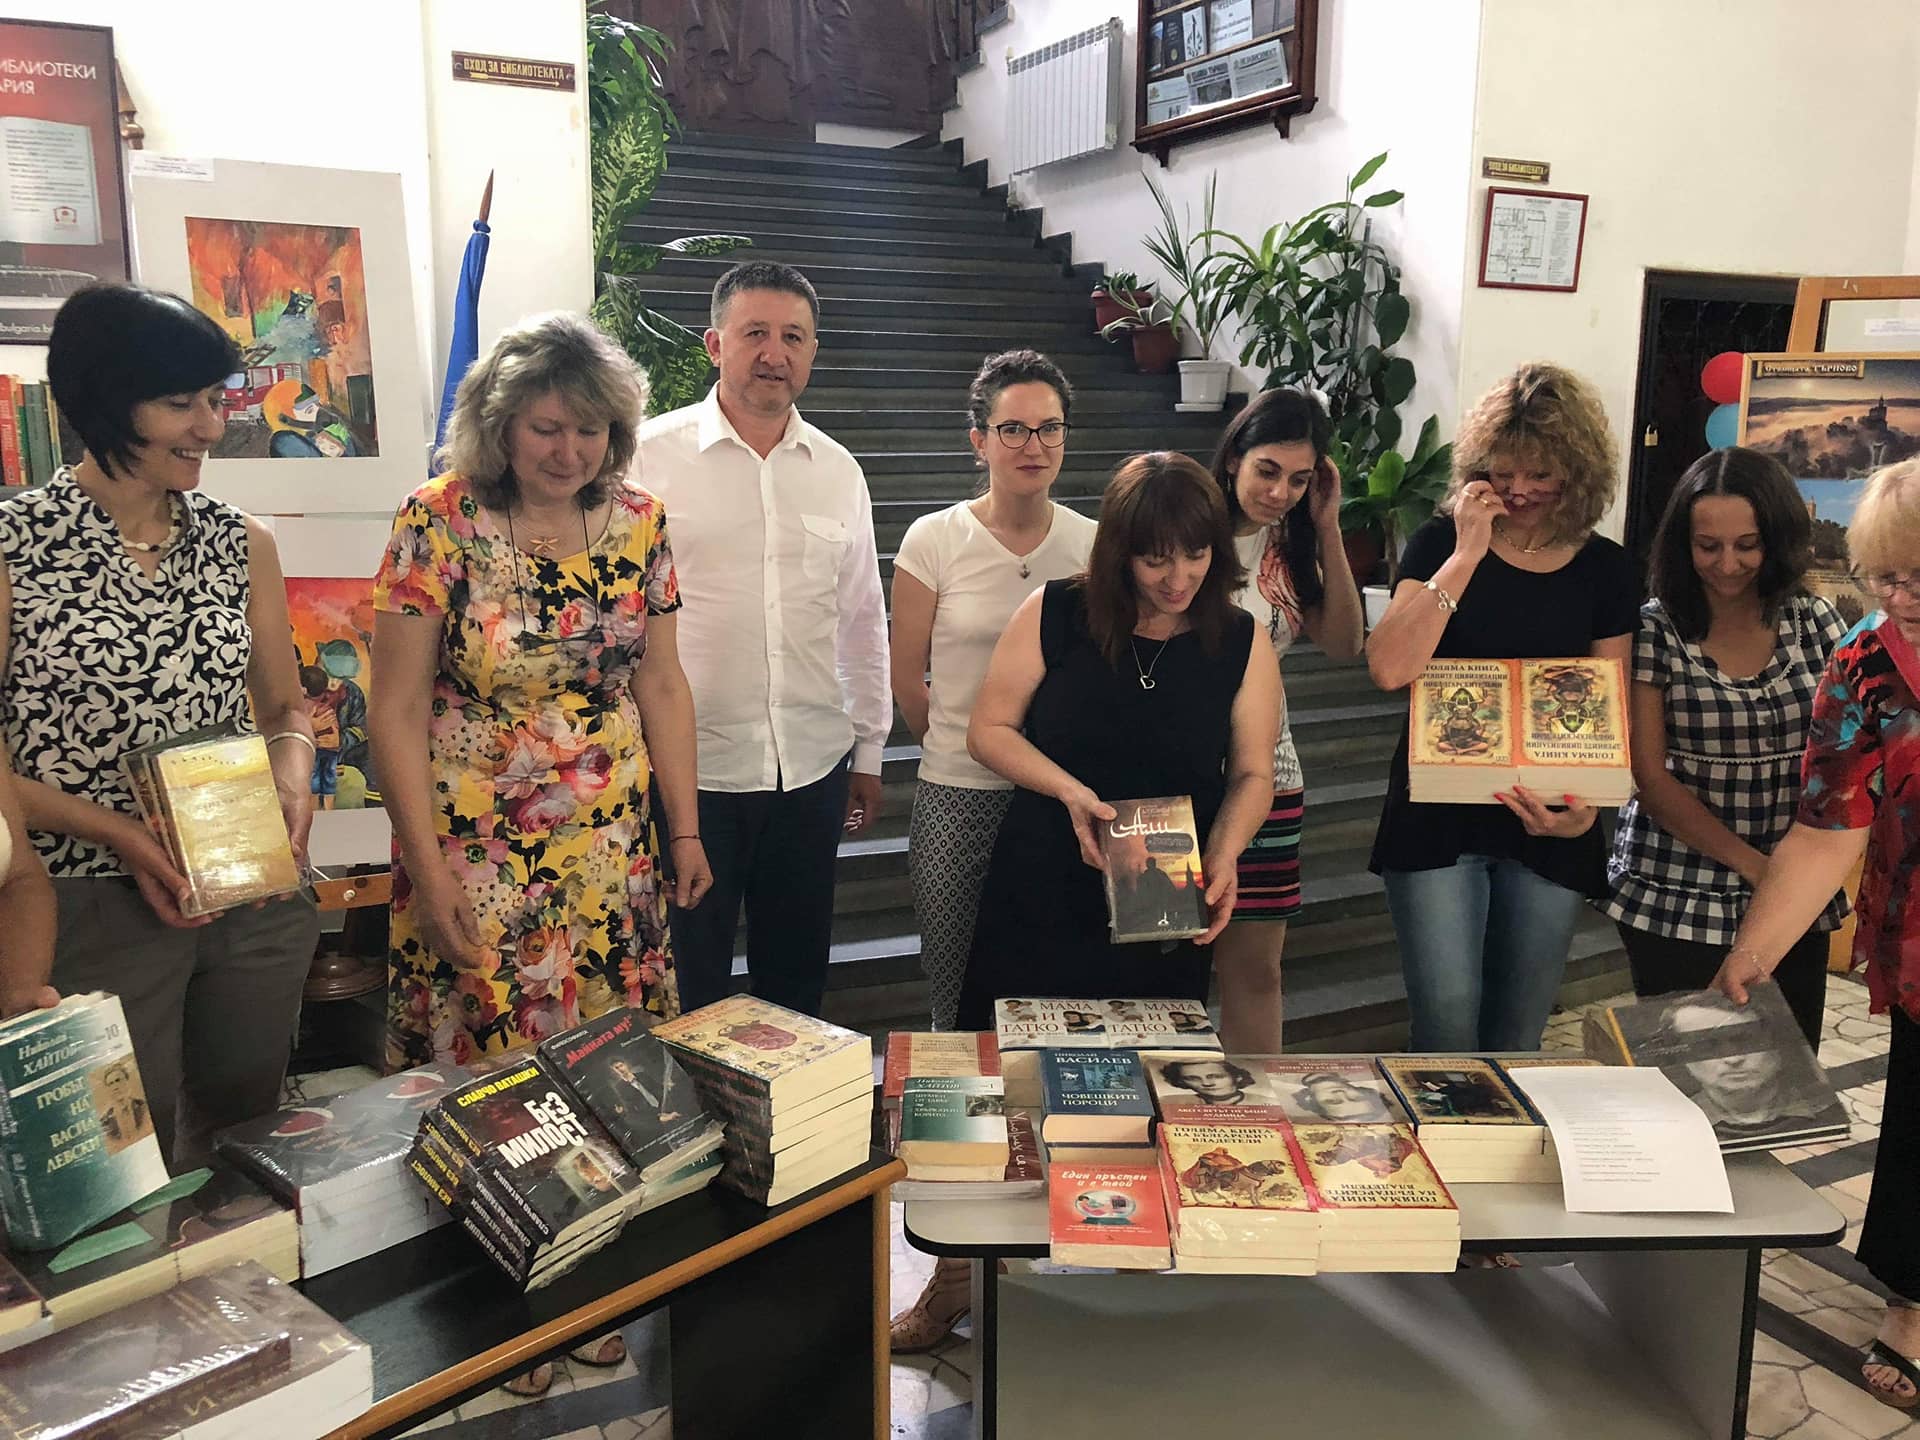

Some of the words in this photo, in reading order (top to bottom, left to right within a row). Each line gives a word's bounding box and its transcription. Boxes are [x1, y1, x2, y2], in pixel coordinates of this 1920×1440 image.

[488, 61, 499, 73] ЗА
[500, 62, 565, 80] БИБЛИОТЕКАТА
[1425, 664, 1465, 672] ГОЛЯМА
[1467, 664, 1501, 672] КНИГА
[1533, 751, 1568, 759] КНИГА
[1571, 752, 1614, 760] ГОЛЯМА
[1039, 1002, 1094, 1011] МАМА
[1143, 1002, 1198, 1011] МАМА
[1042, 1013, 1056, 1021] И
[1147, 1013, 1161, 1021] И
[1002, 1023, 1059, 1033] ТАТКО
[1111, 1023, 1167, 1033] ТАТКО
[456, 1085, 498, 1107] СЛАВЧО
[494, 1067, 540, 1091] ВАТАШКИ
[36, 1076, 85, 1110] ГРОБЪТ
[69, 1094, 91, 1116] НА
[523, 1092, 570, 1125] БЕЗ
[497, 1112, 589, 1168] МИЛОСТ
[47, 1135, 100, 1173] ЛЕВСКИ
[411, 1159, 441, 1194] МИЛОСТ
[1061, 1171, 1090, 1179] Един
[1095, 1172, 1148, 1181] пръстен
[438, 1190, 453, 1206] БЕЗ
